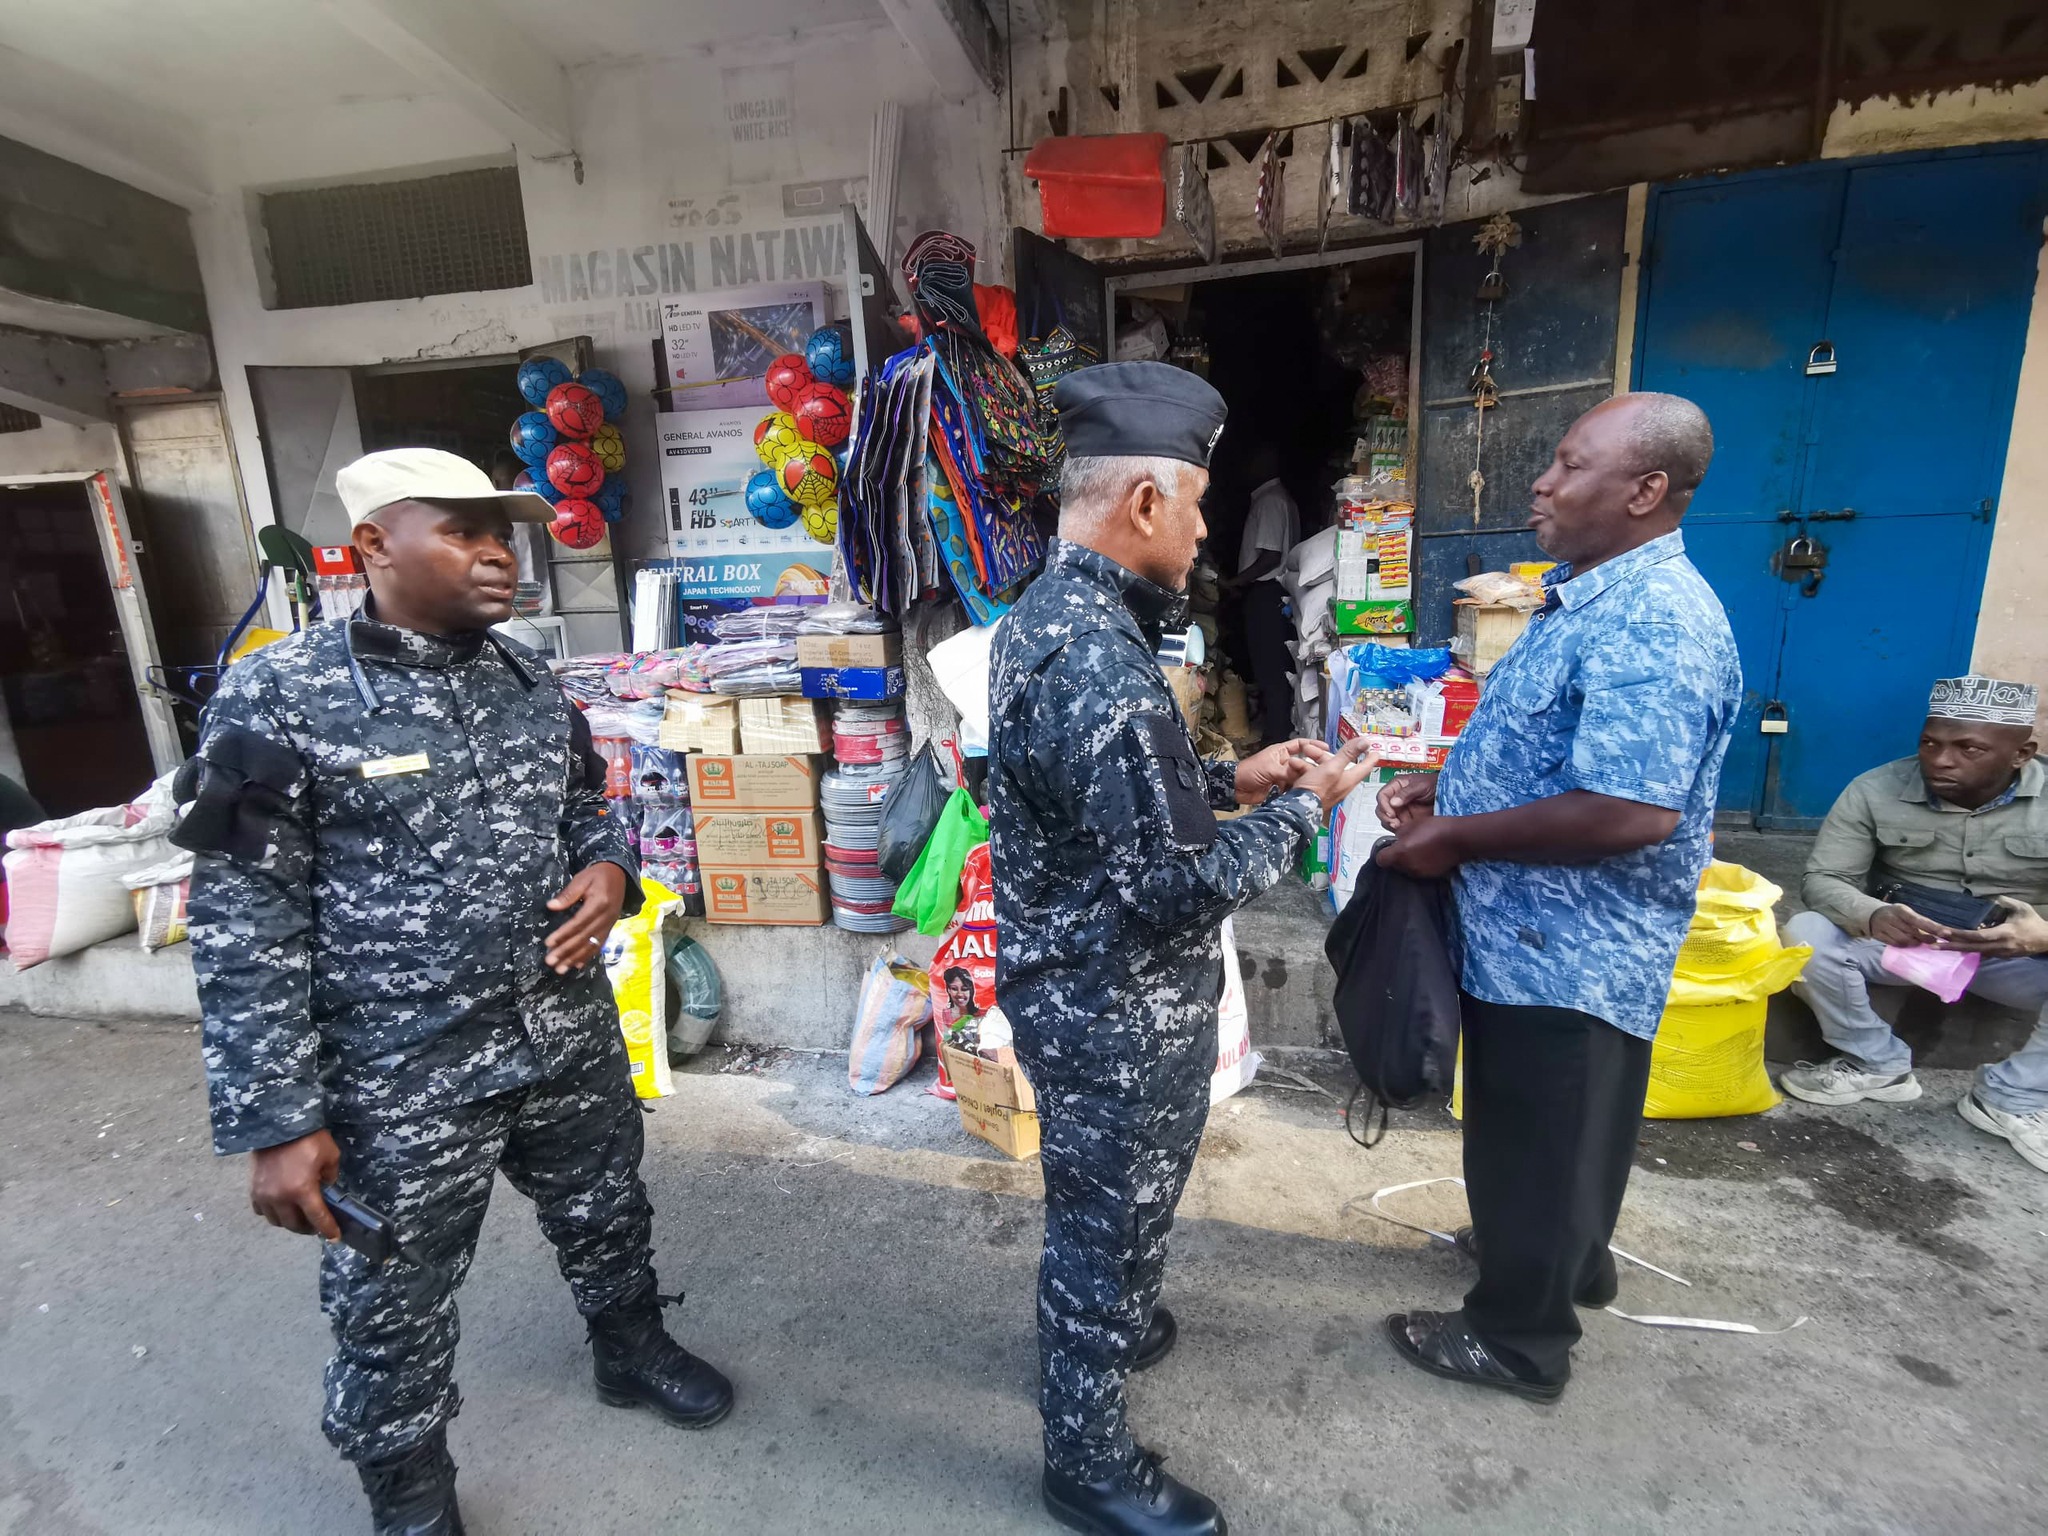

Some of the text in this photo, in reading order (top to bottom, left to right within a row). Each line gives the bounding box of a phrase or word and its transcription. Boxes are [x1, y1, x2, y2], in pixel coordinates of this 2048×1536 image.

[732, 119, 791, 142] WHITE RICE
[539, 241, 697, 303] MAGASIN
[692, 322, 701, 330] TV
[663, 428, 743, 442] GENERAL AVANOS
[691, 509, 716, 518] FULL
[690, 517, 716, 530] HD
[723, 563, 762, 582] BOX
[683, 585, 761, 596] JAPAN TECHNOLOGY
